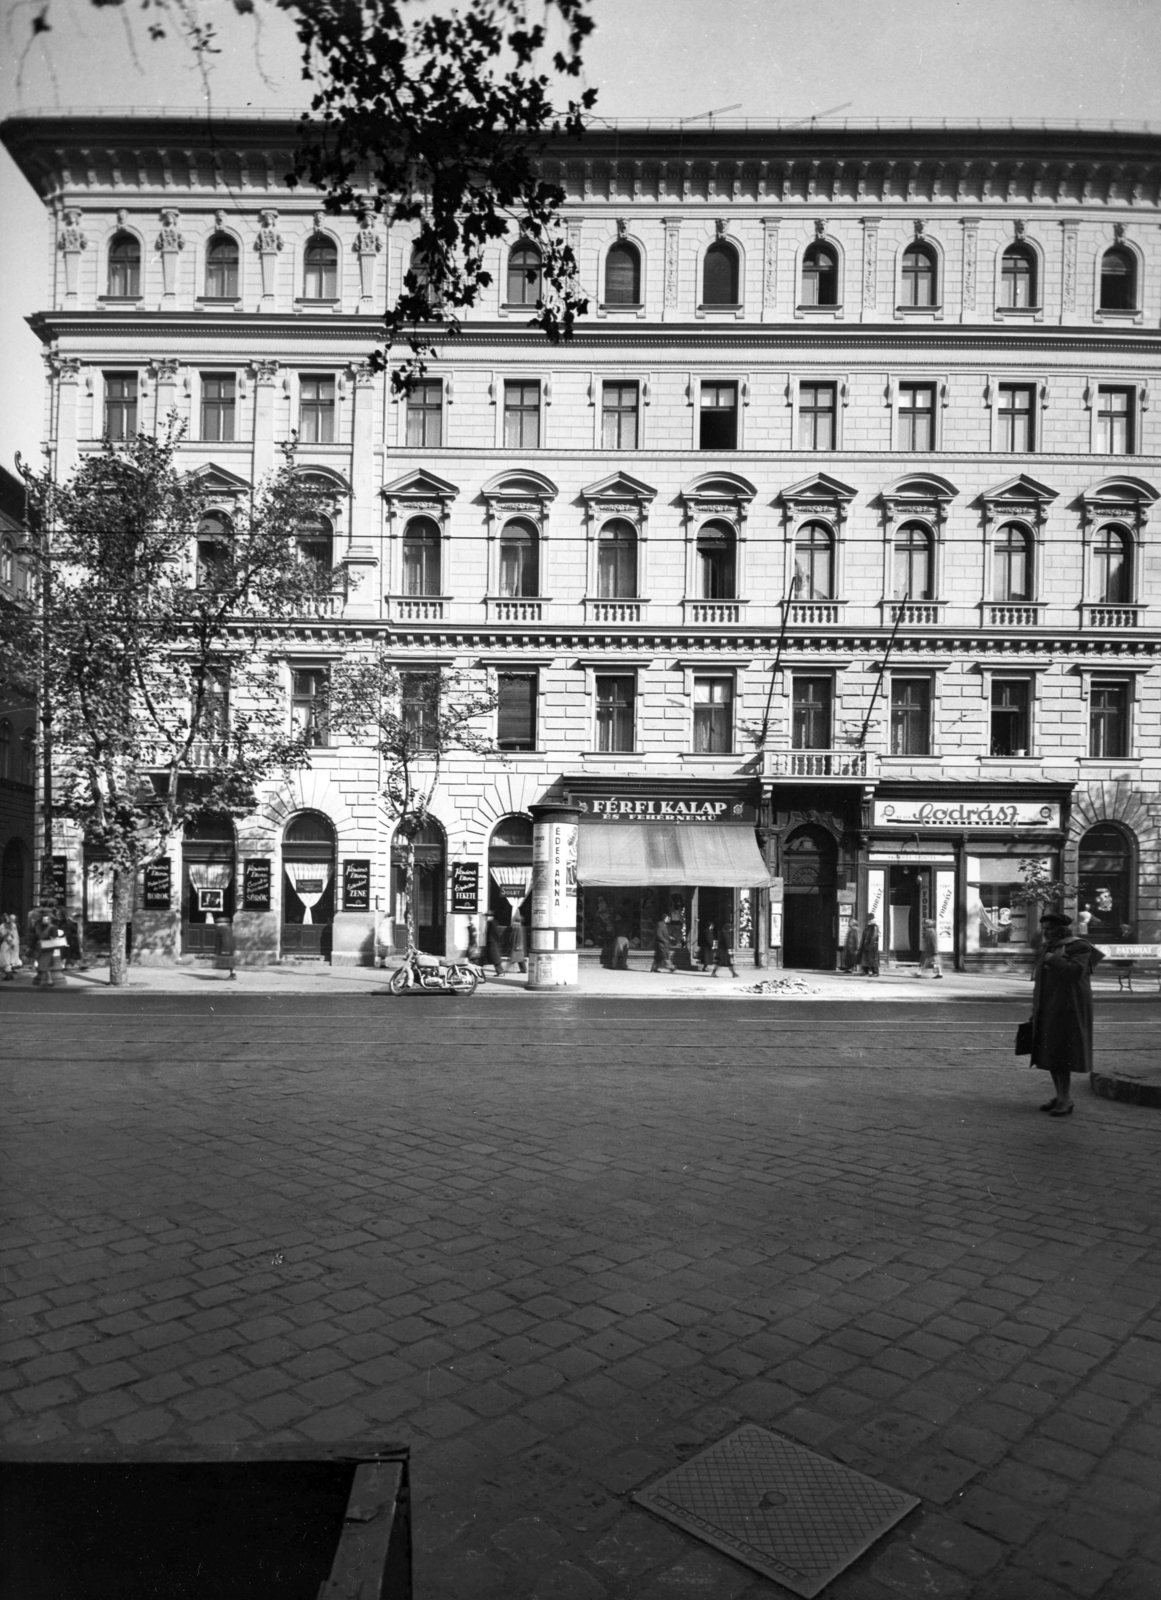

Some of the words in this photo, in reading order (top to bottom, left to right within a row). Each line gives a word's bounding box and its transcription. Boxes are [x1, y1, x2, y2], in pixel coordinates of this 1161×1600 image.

[593, 797, 655, 814] FÉRFI
[660, 800, 727, 815] KALAP
[1116, 946, 1152, 954] PATYOLAT
